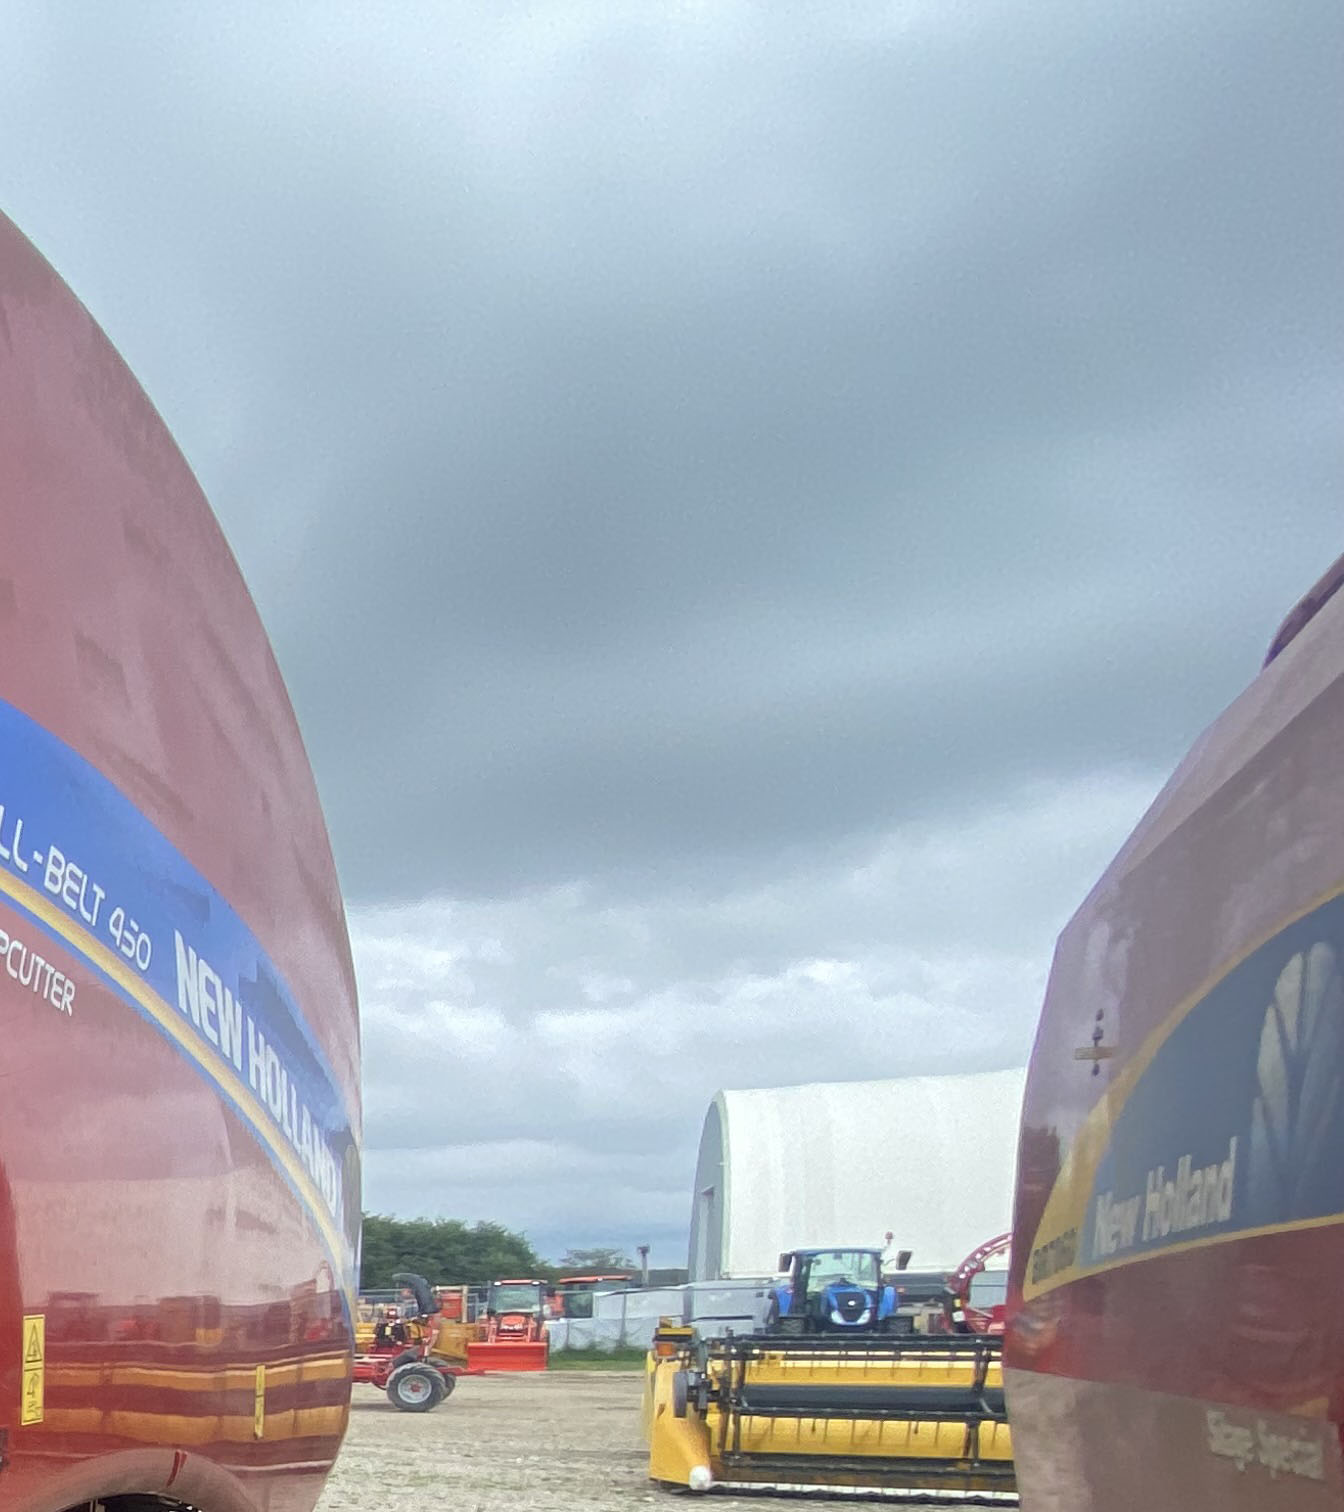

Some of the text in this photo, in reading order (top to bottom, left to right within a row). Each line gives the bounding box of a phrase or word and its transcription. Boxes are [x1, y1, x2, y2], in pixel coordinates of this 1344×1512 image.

[109, 906, 152, 971] 450
[174, 929, 338, 1217] NEW HOLLAND
[1093, 1191, 1141, 1258] New
[1143, 1135, 1238, 1242] Holland
